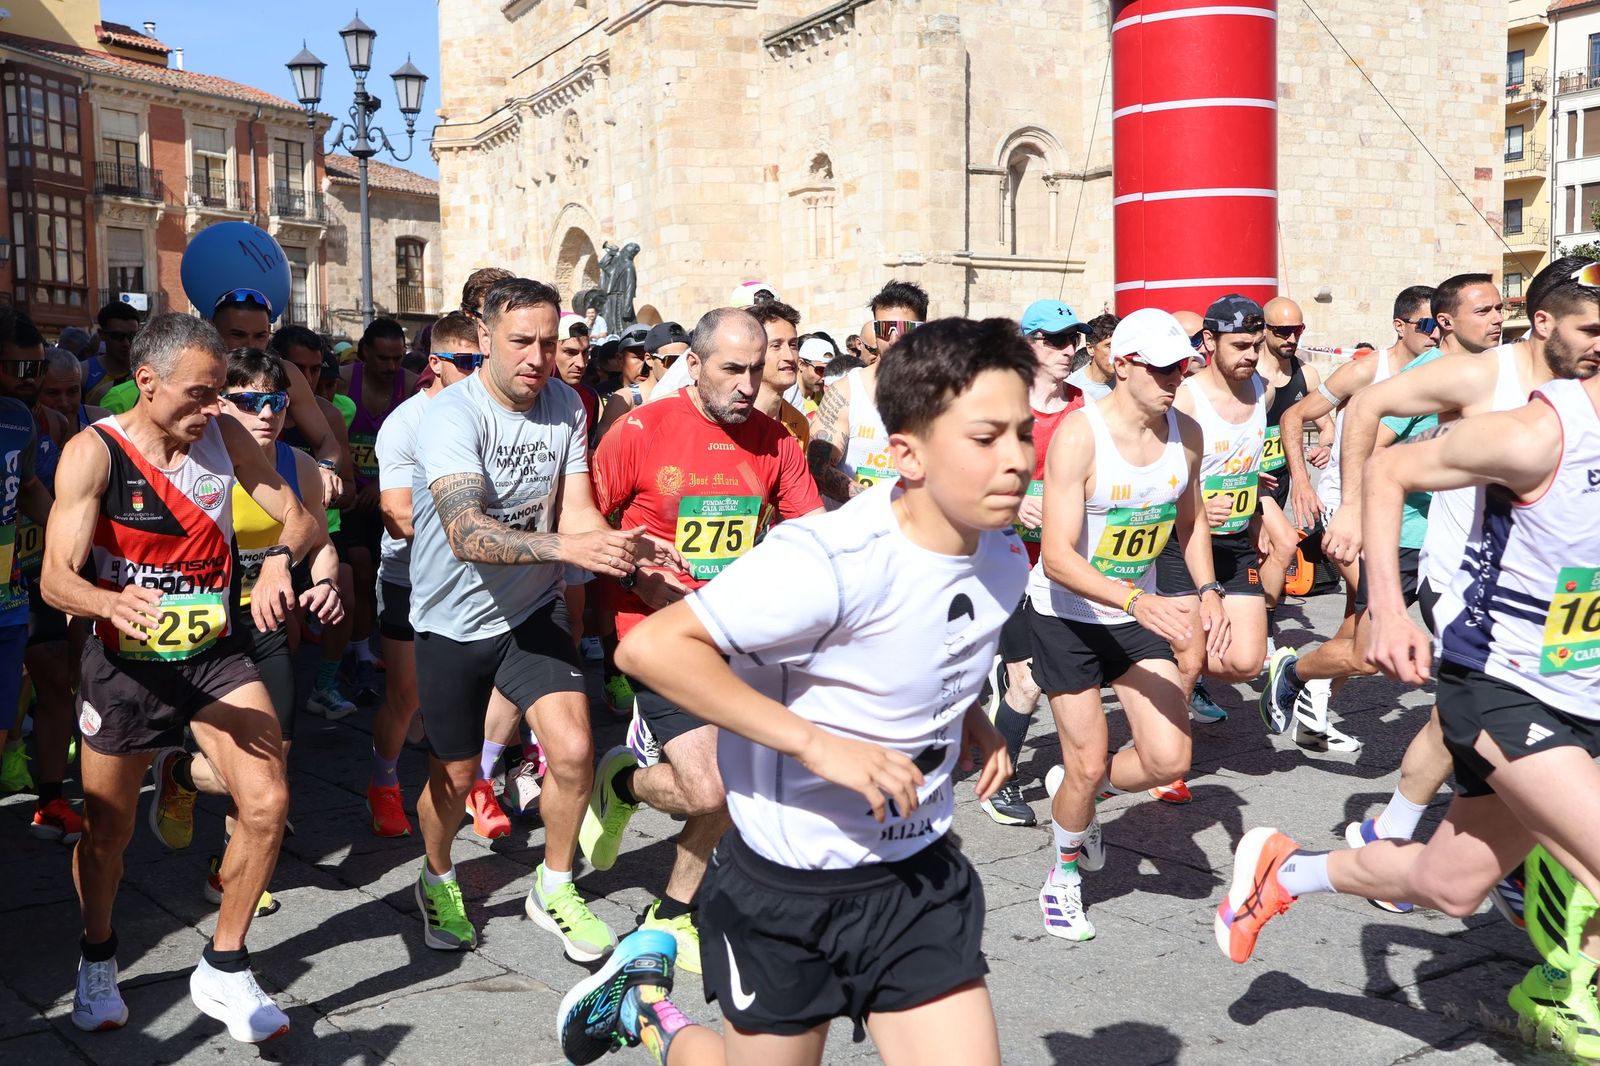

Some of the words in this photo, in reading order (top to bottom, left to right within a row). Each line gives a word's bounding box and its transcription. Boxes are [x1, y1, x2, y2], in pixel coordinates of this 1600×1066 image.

[511, 441, 548, 456] MEDIA
[519, 465, 538, 477] 10K
[525, 475, 551, 484] ZAMORA
[503, 502, 544, 523] ZAMORA
[681, 520, 744, 553] 275
[1112, 526, 1159, 557] 161
[124, 555, 224, 573] ATLETISMO
[698, 564, 720, 574] CAJA
[1114, 566, 1135, 574] CAJA
